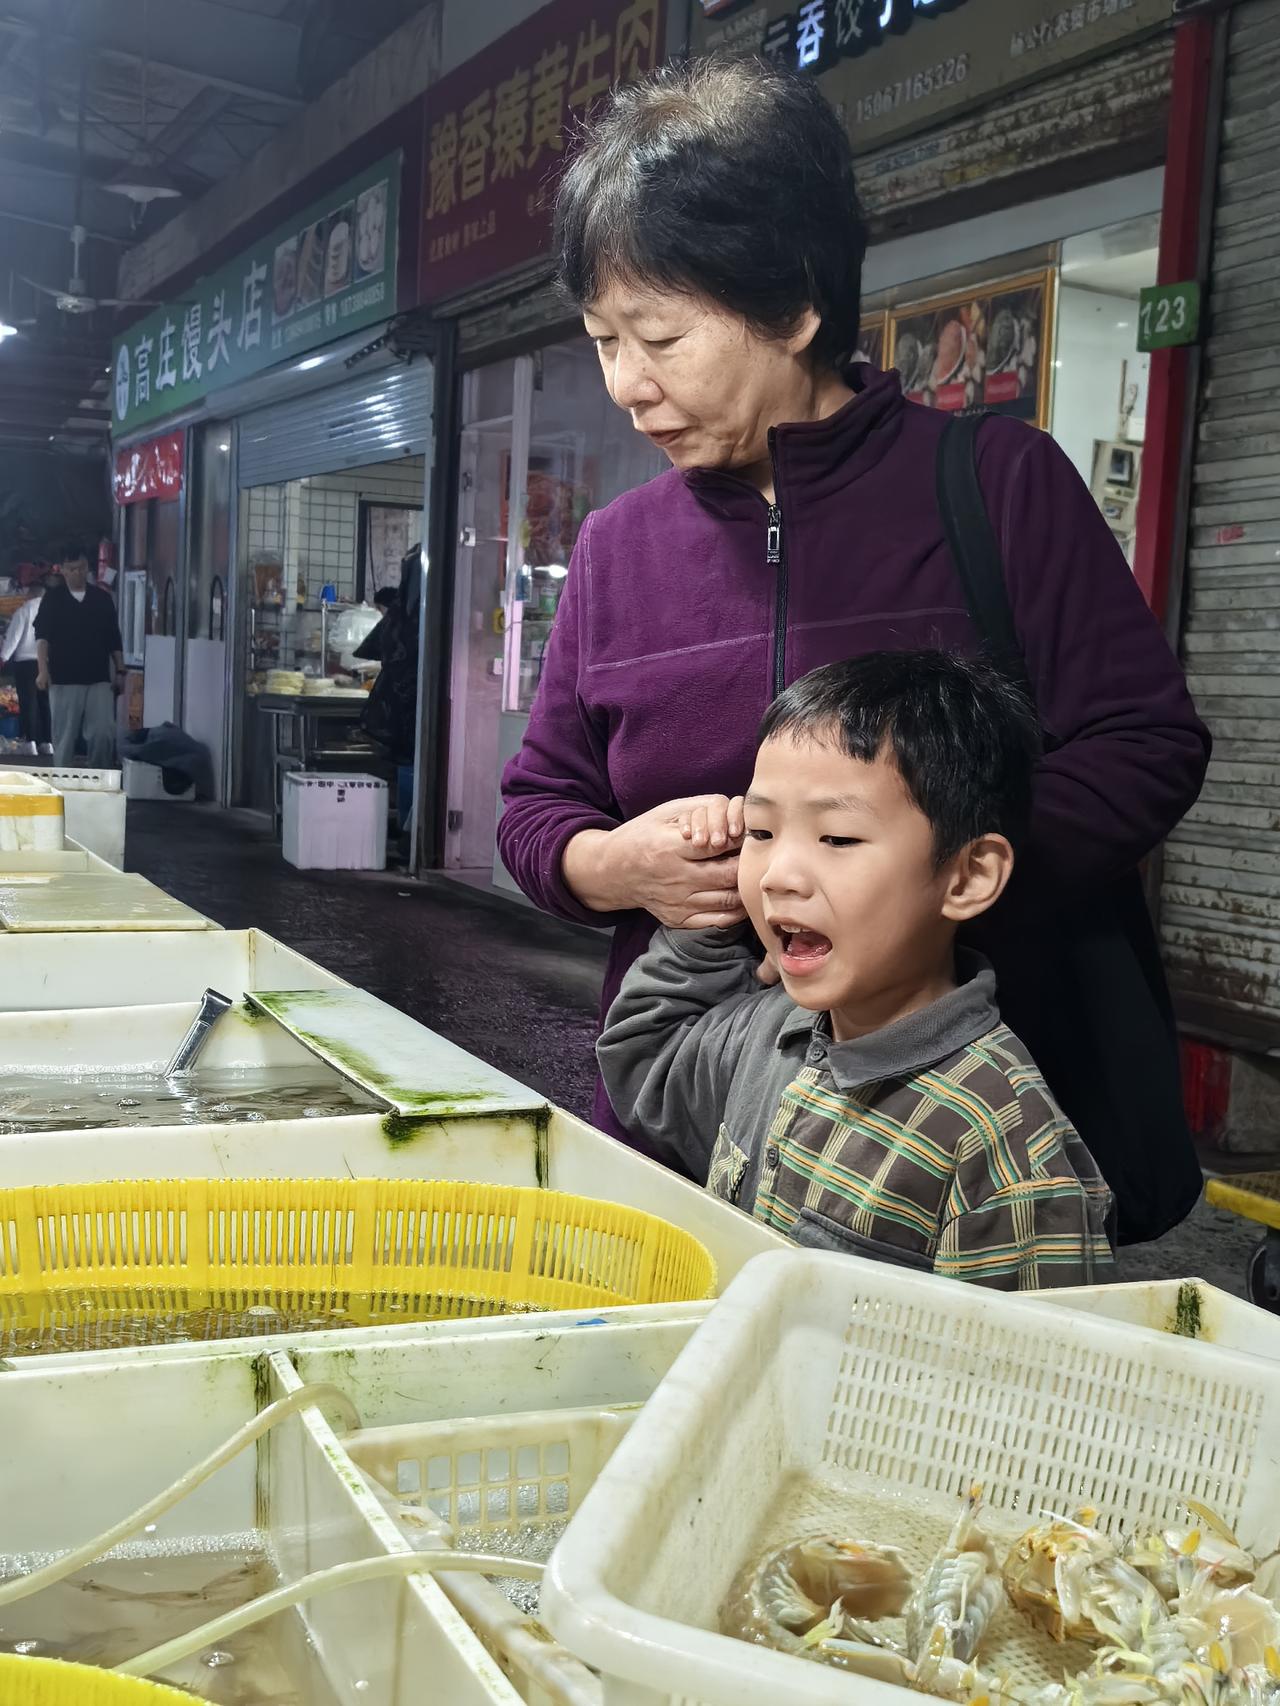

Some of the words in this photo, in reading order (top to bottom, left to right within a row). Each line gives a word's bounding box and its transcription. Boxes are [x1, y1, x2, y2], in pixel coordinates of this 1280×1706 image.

[856, 55, 967, 125] 15067165326
[134, 260, 268, 407] 高庄馒头店
[1141, 295, 1185, 337] 123
